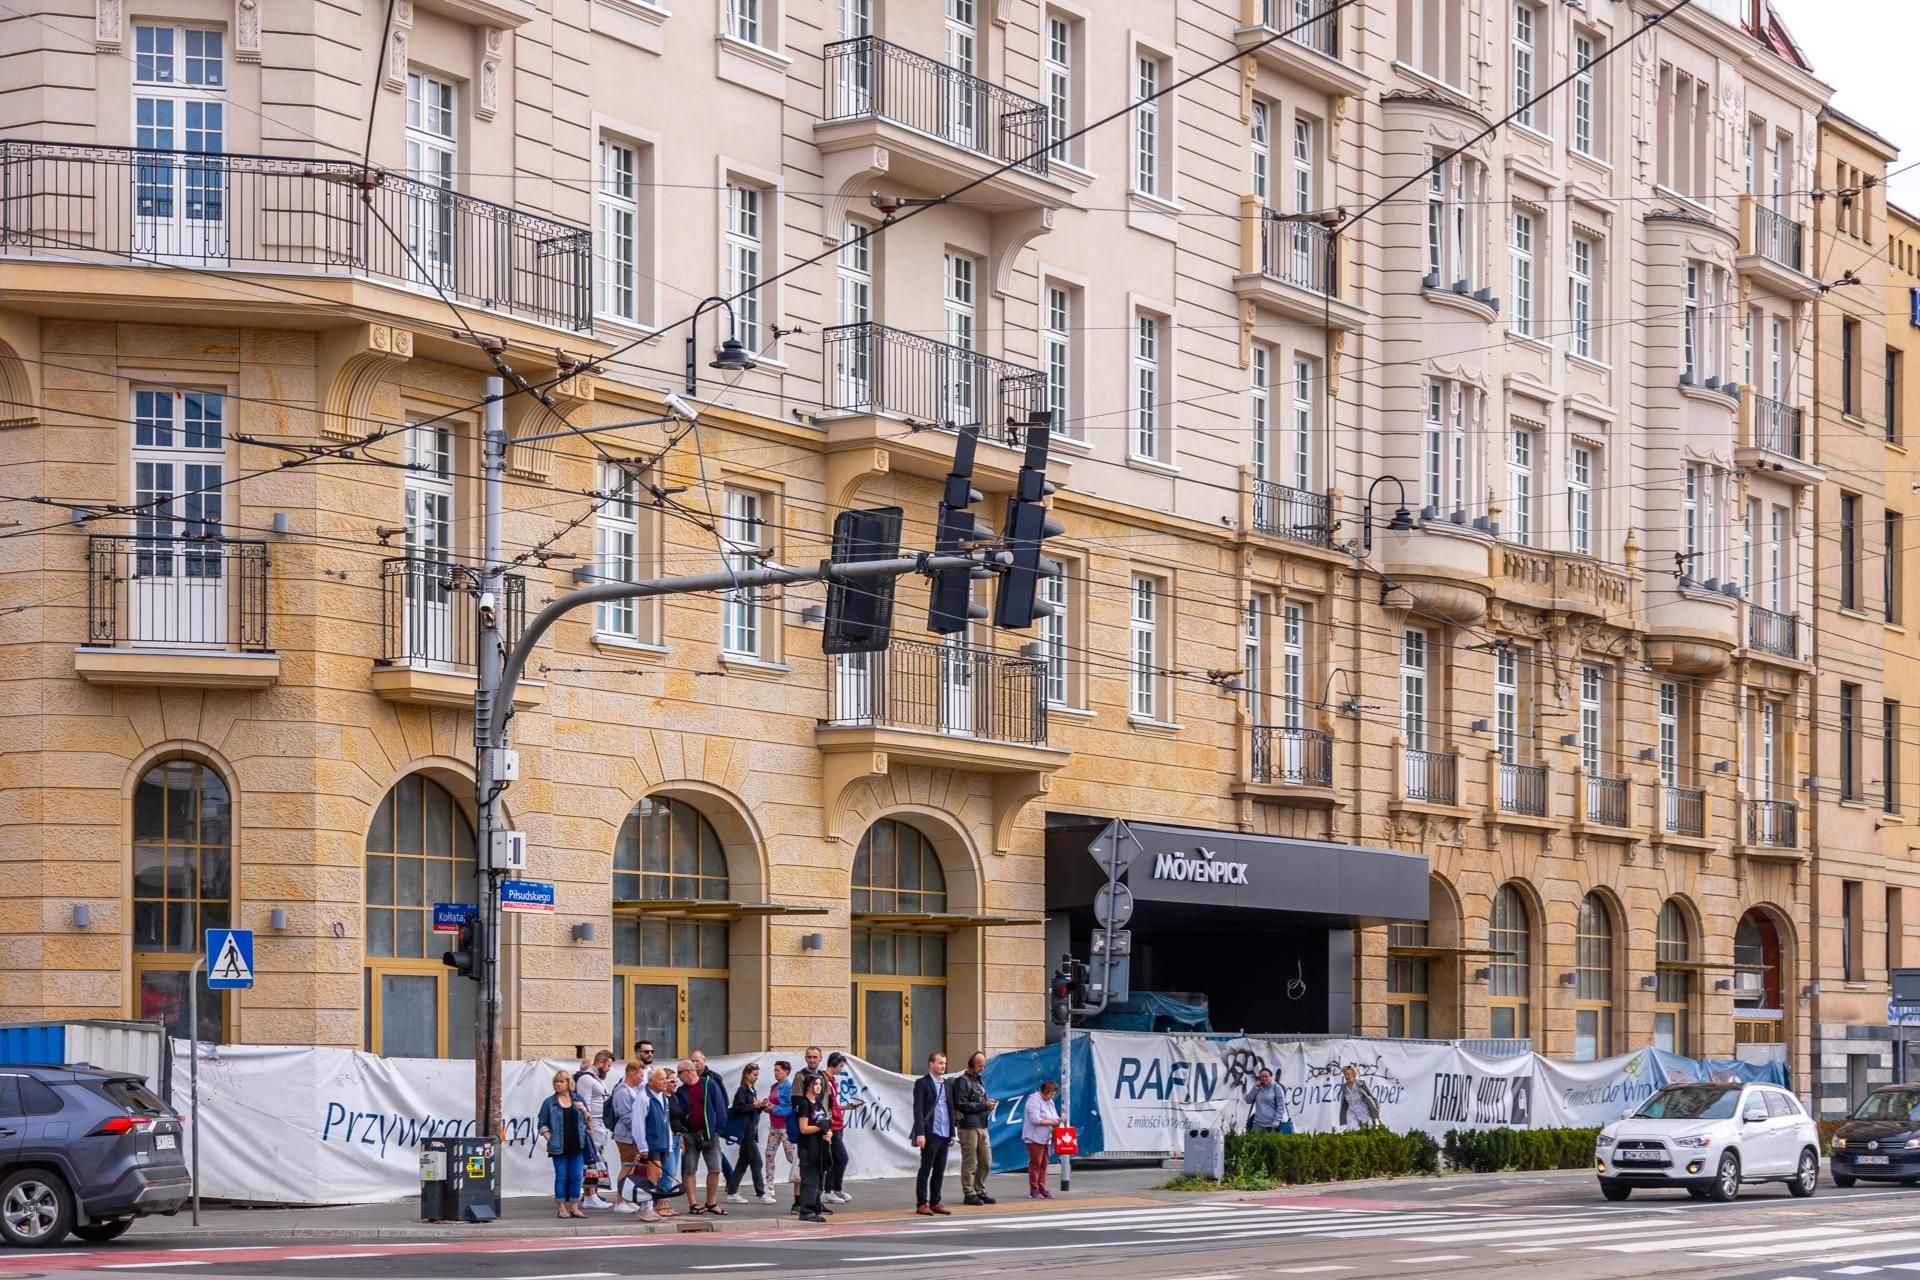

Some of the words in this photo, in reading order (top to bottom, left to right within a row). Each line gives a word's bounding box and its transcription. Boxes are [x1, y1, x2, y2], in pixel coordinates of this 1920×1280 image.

[1153, 851, 1249, 885] MÖVENPICK
[508, 889, 551, 904] Piłsudskiego
[438, 911, 467, 924] Kołłątaj
[1114, 1057, 1218, 1103] RAFN
